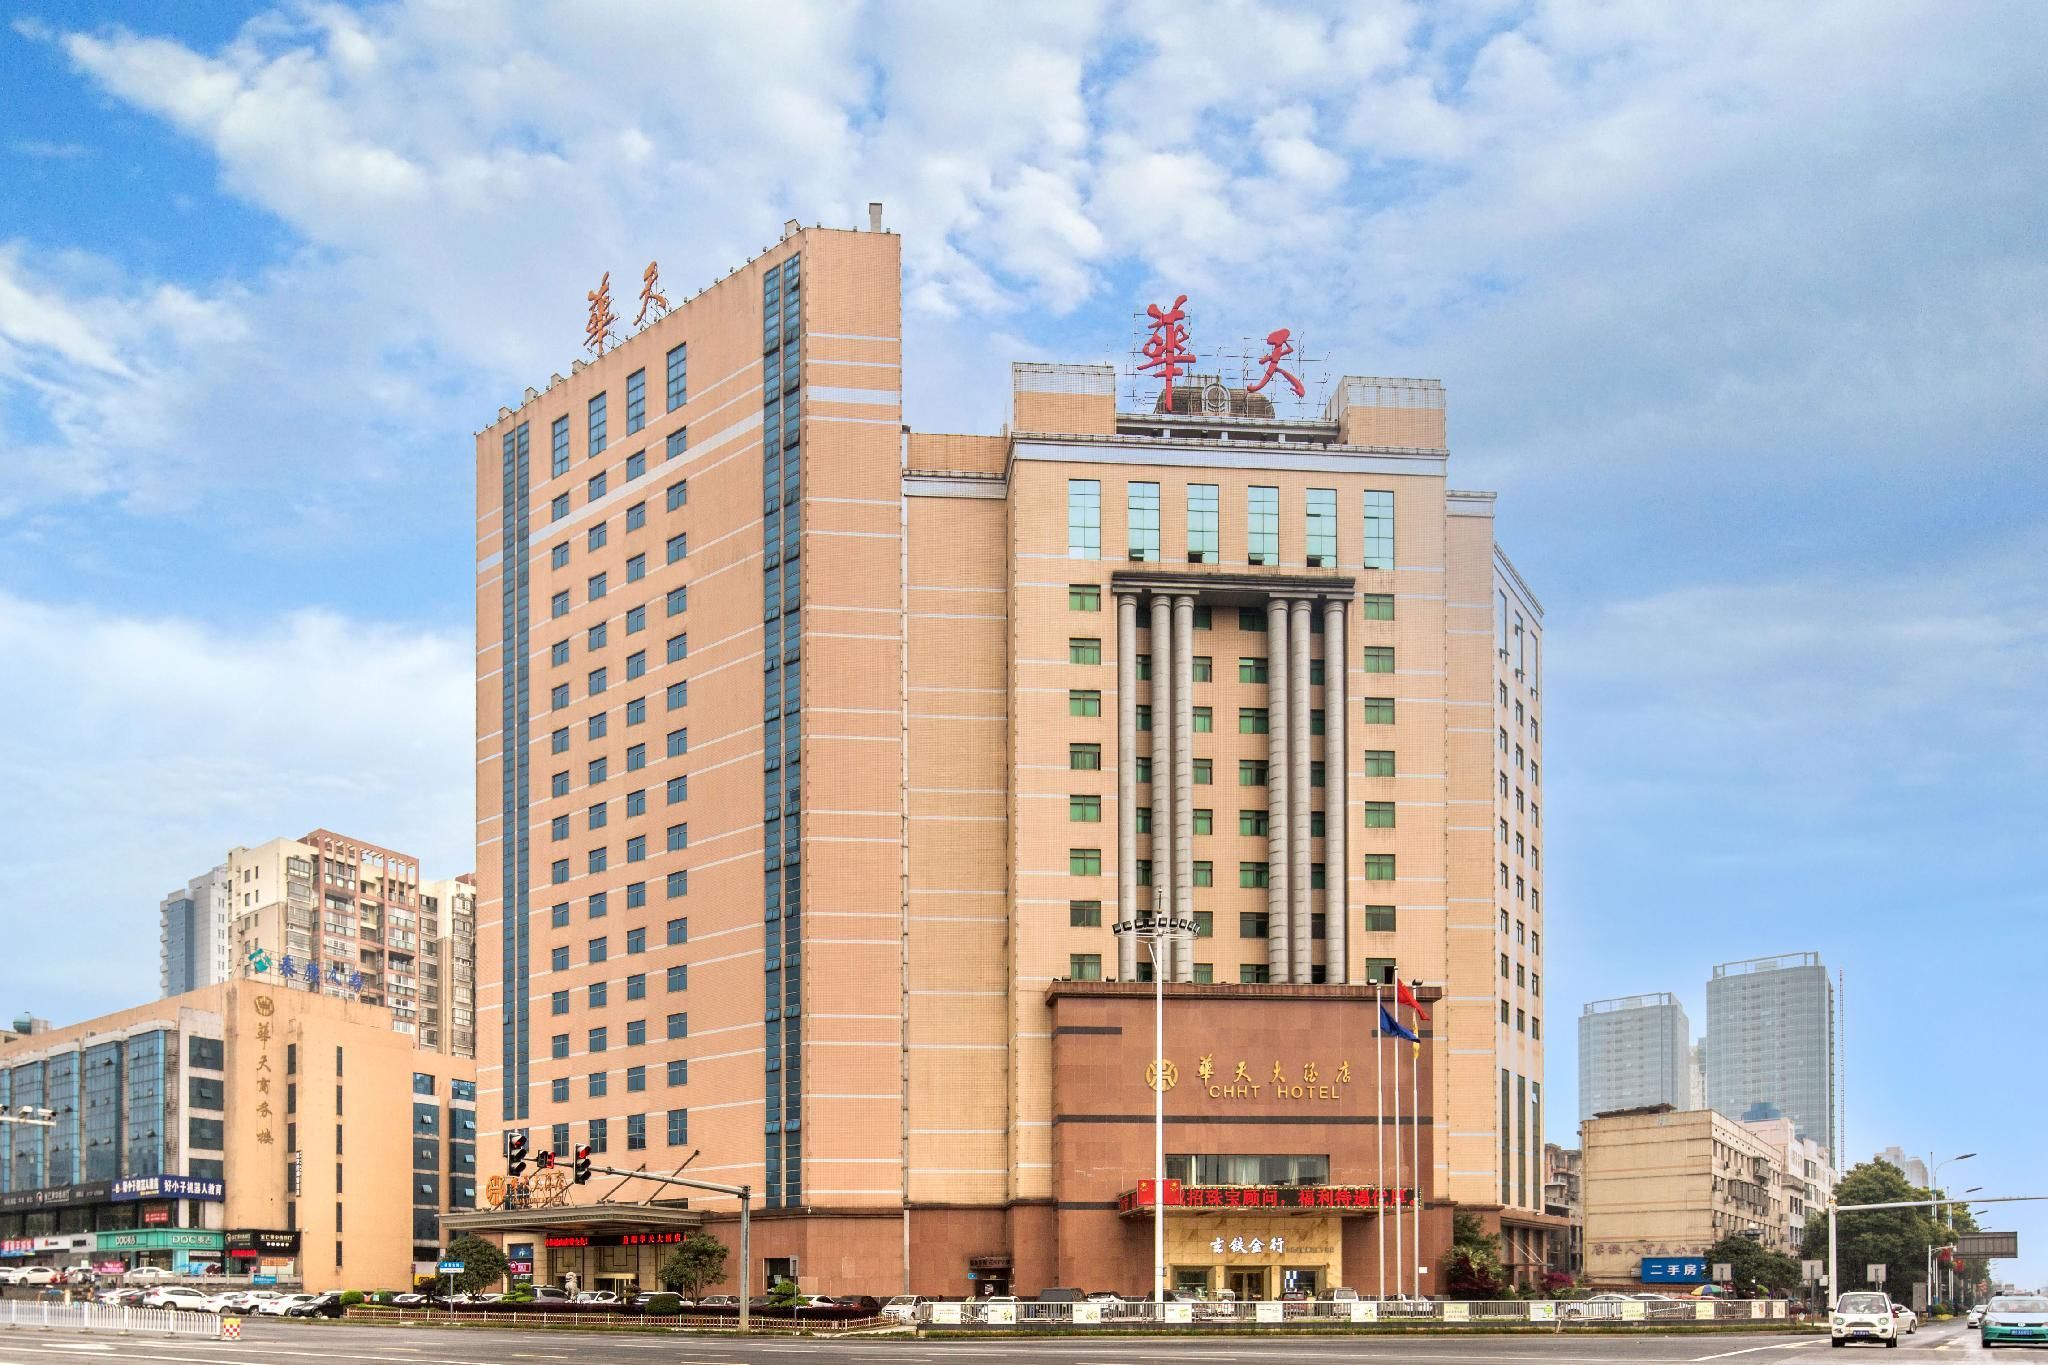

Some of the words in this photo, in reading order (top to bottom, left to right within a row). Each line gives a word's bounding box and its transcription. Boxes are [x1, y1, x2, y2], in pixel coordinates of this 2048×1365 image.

[1209, 1085, 1261, 1099] CHHT
[1277, 1085, 1341, 1099] HOTEL
[164, 1179, 223, 1196] 好小子机器人教育
[1181, 1188, 1415, 1207] 招珠宝顾问，福利待遇优厚。
